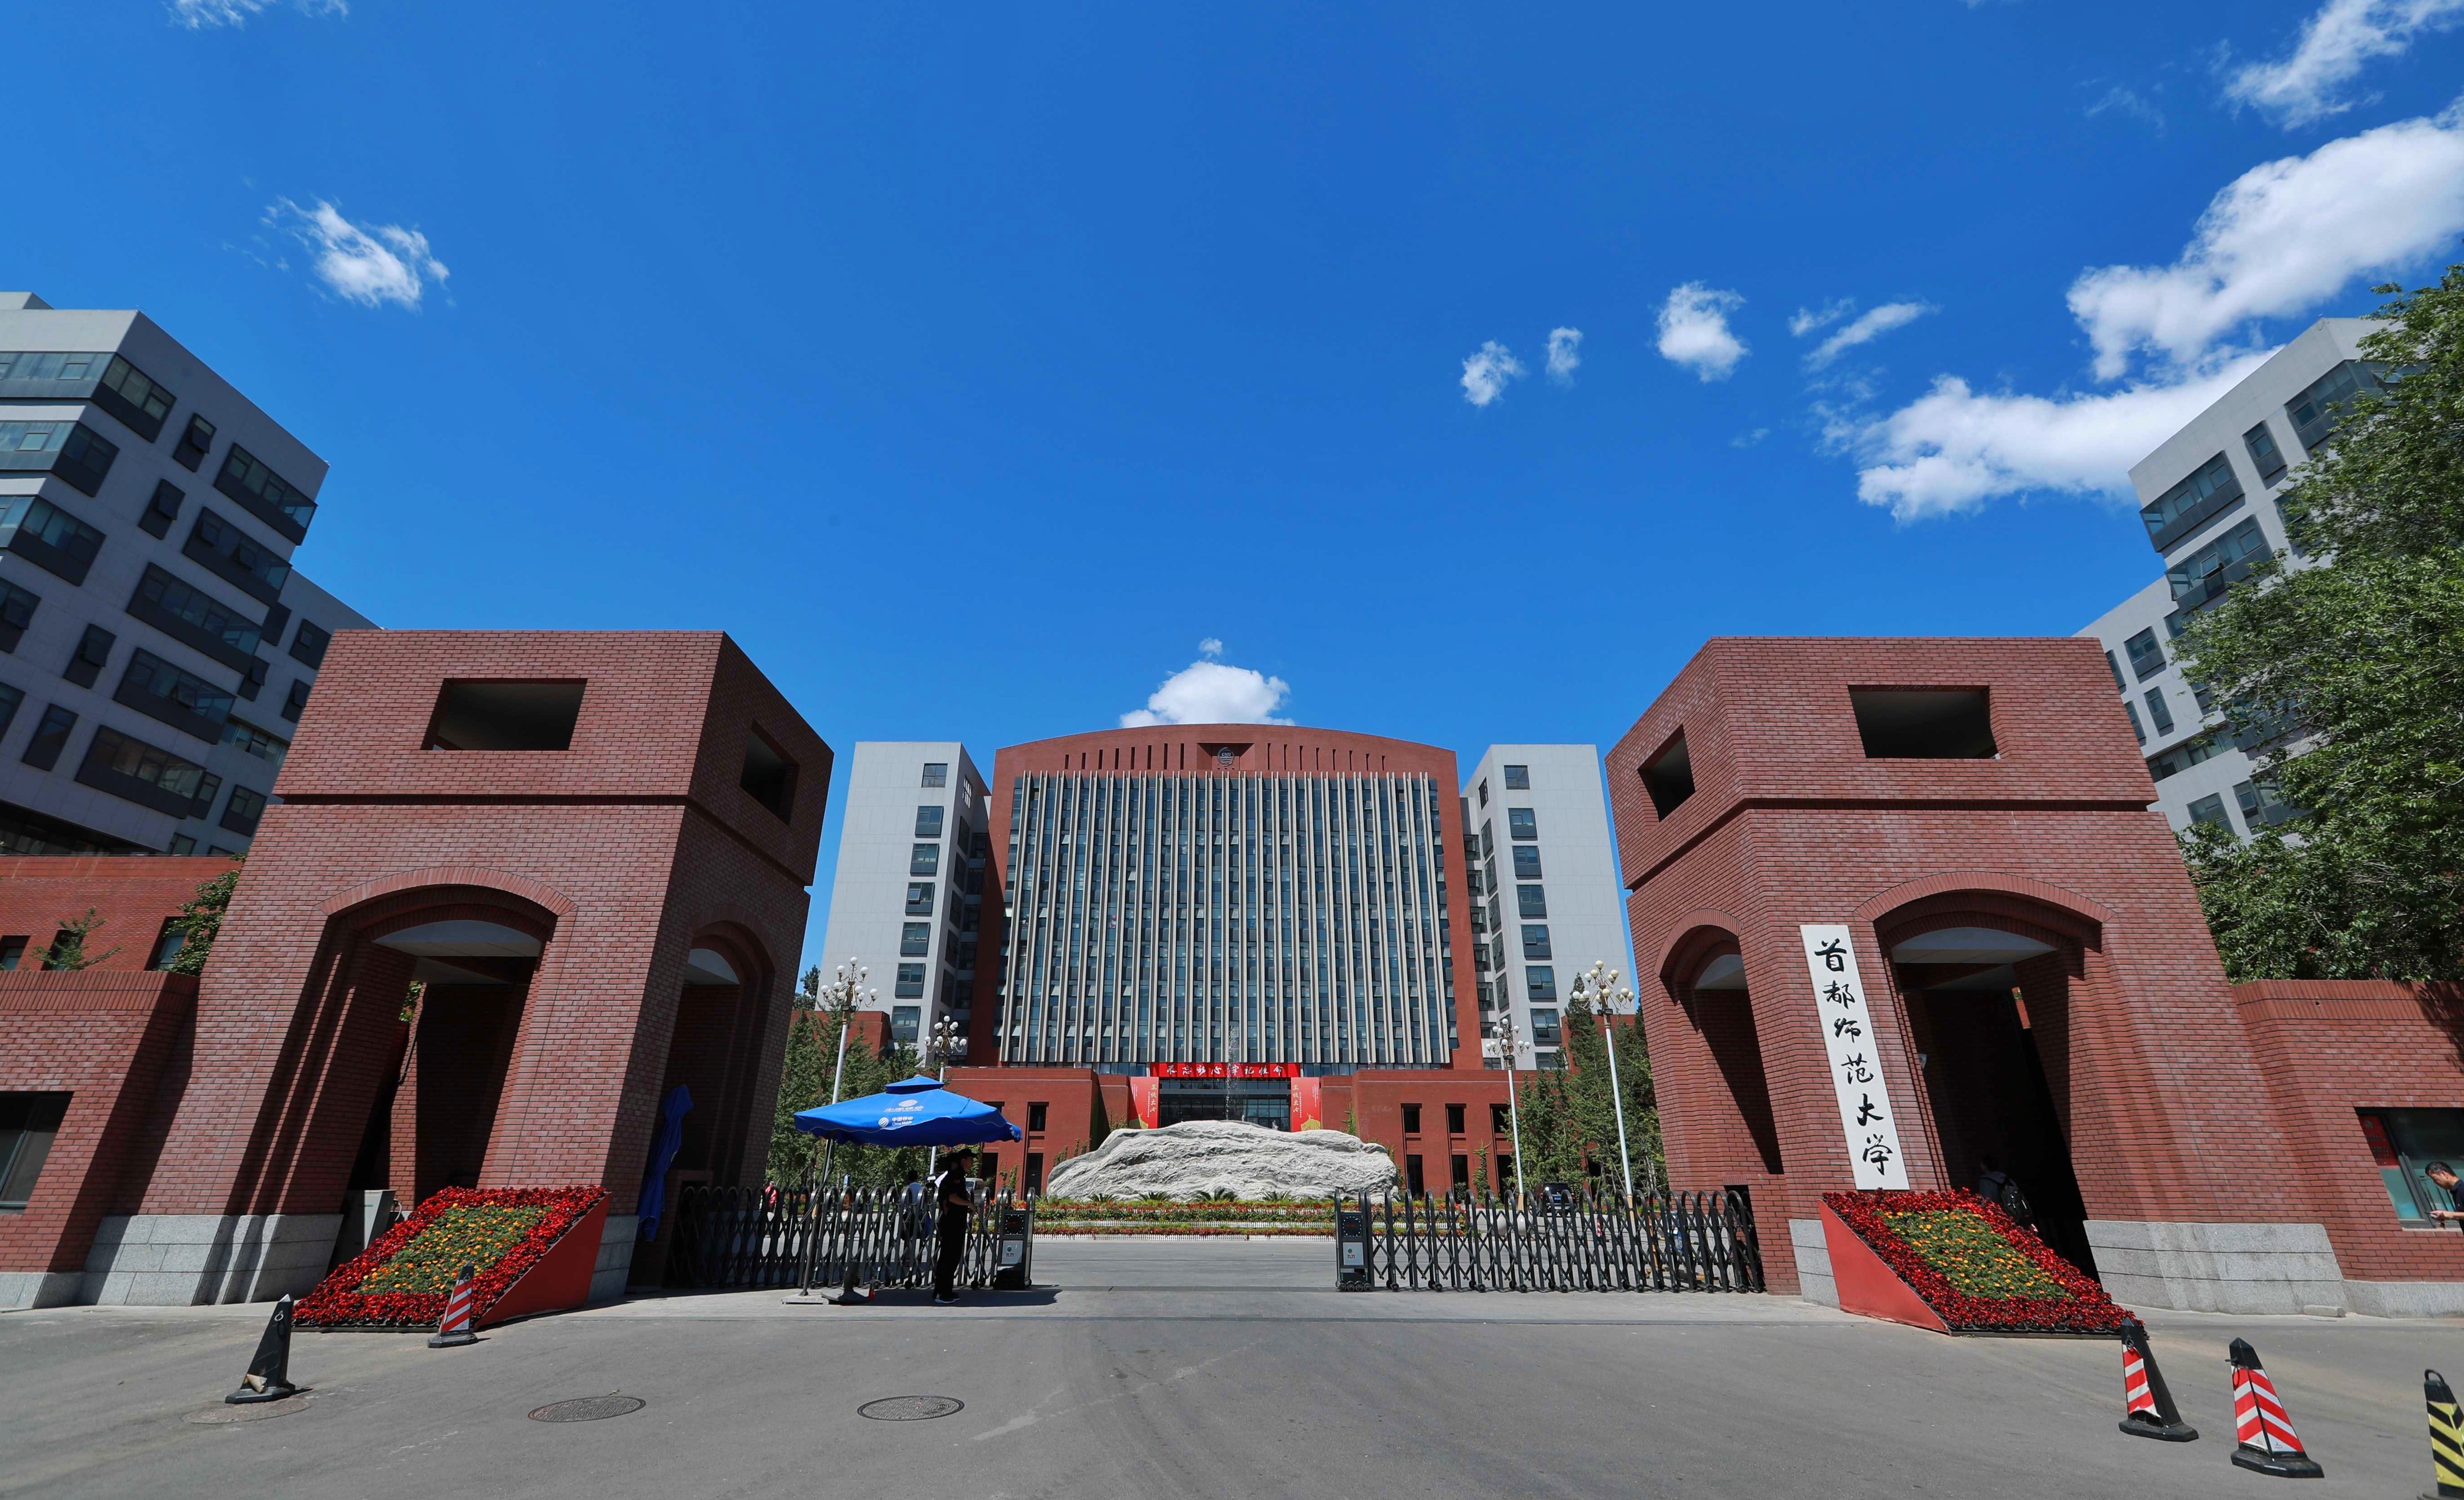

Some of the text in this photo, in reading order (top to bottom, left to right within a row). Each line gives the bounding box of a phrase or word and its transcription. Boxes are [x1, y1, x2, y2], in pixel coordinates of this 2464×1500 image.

[1815, 938, 1893, 1175] 首都师范大学
